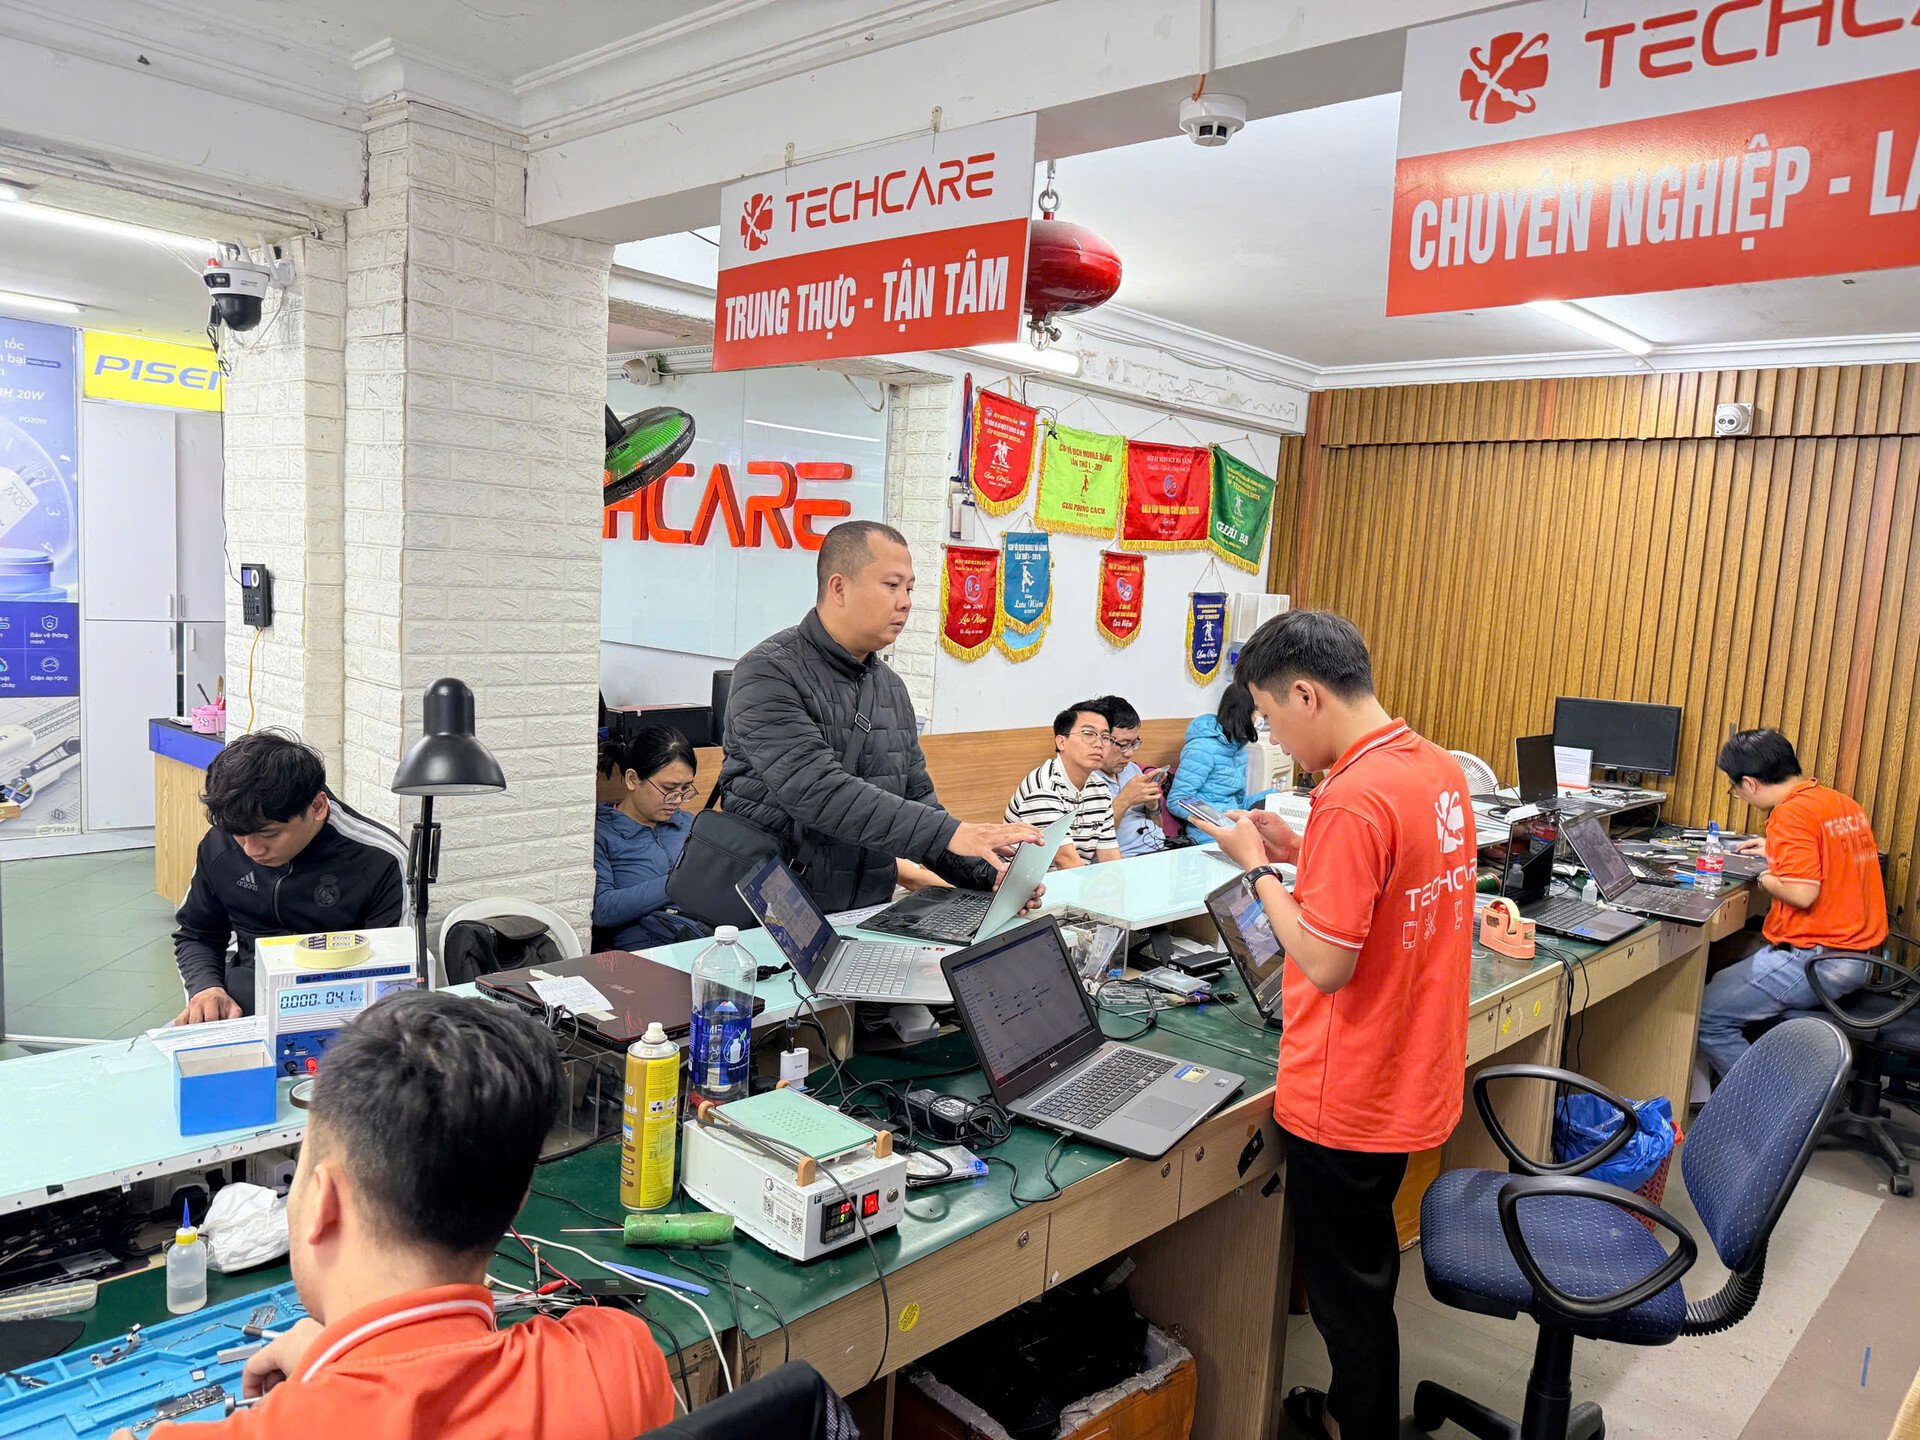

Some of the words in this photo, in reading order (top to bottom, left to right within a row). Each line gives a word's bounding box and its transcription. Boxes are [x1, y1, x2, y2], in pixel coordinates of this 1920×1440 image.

[1584, 0, 1920, 89] TECHC
[785, 152, 995, 233] TECHCARE
[1409, 168, 1592, 271] CHUYÊN
[1606, 133, 1811, 251] NGHIỆP
[1828, 175, 1851, 195] -
[725, 287, 790, 342] TRUNG
[797, 273, 857, 340] THỰC
[863, 298, 873, 309] -
[882, 258, 936, 333] TẬN
[944, 248, 1009, 316] TÂM
[17, 390, 45, 400] 20W
